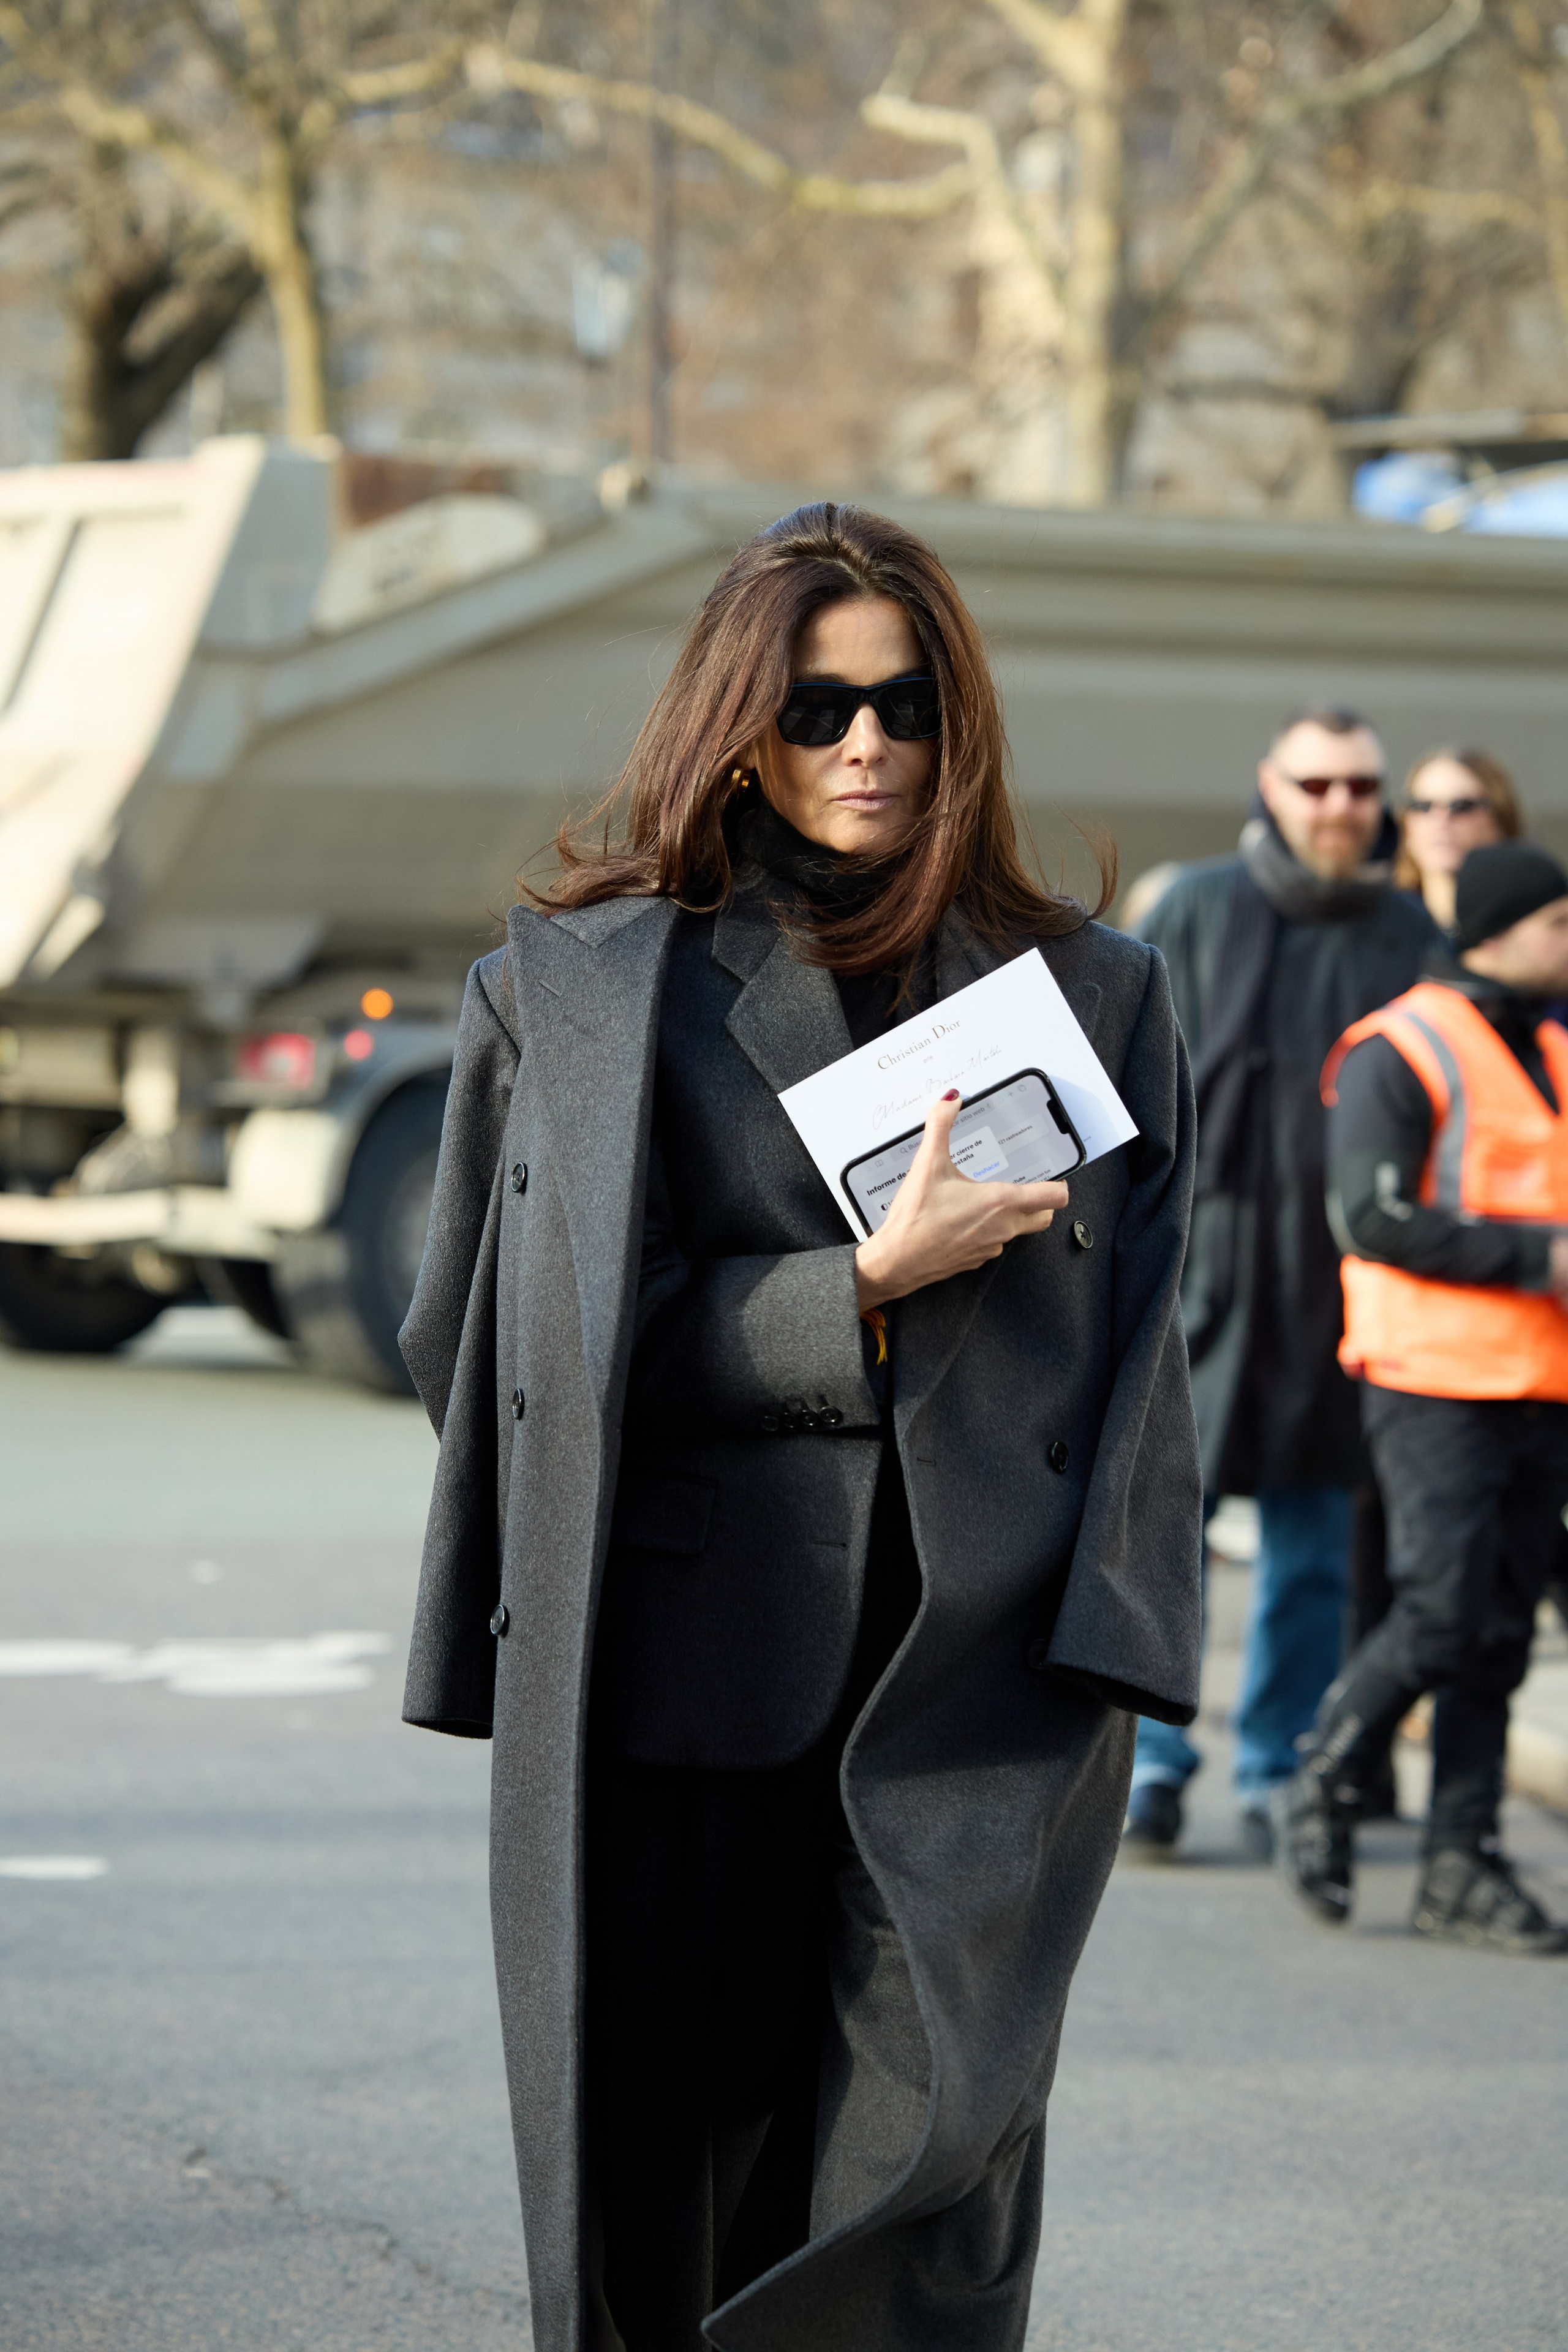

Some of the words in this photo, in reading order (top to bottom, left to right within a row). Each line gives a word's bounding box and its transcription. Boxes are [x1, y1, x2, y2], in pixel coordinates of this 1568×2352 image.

[878, 1038, 931, 1069] Christian
[932, 1020, 960, 1038] Dior
[872, 1095, 924, 1130] Madame
[925, 1071, 964, 1093] Barbara
[960, 1114, 973, 1123] sitio
[973, 1107, 986, 1116] web
[1006, 1125, 1033, 1142] rastreadores
[956, 1144, 974, 1156] cierre
[973, 1161, 1000, 1178] Deshacer
[867, 1177, 897, 1196] Informe
